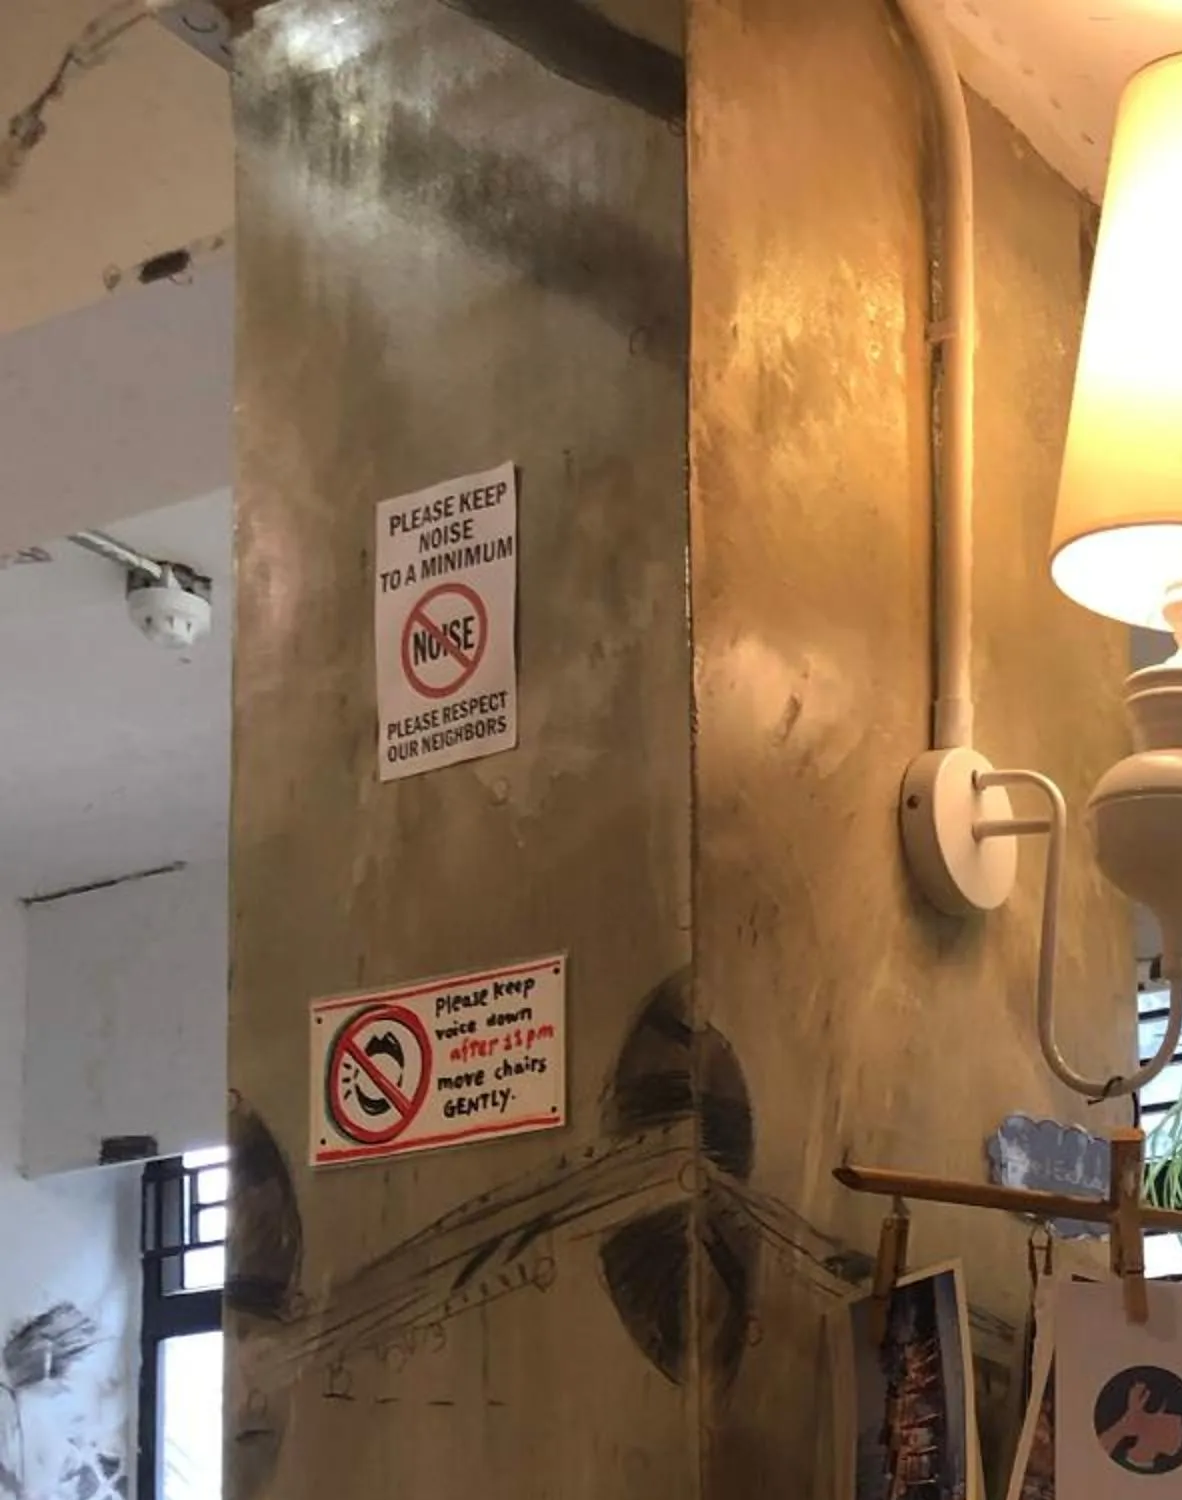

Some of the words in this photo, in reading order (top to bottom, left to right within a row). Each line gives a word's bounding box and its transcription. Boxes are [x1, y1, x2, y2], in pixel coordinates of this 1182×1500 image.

[389, 495, 454, 537] PLEASE
[459, 481, 507, 513] KEEP
[419, 518, 474, 553] NOISE
[380, 571, 401, 593] TO
[404, 565, 417, 585] A
[421, 535, 513, 580] MINIMUM
[412, 616, 475, 666] NOISE
[386, 713, 440, 741] PLEASE
[442, 691, 508, 725] RESPECT
[386, 738, 418, 763] OUR
[421, 716, 507, 752] NEIGHBORS
[493, 977, 535, 999] keep
[435, 1019, 477, 1041] voice
[486, 1007, 532, 1028] down
[449, 1035, 498, 1063] after
[437, 1070, 485, 1090] move
[494, 1056, 547, 1081] chairs
[443, 1088, 516, 1118] GENTLY.
